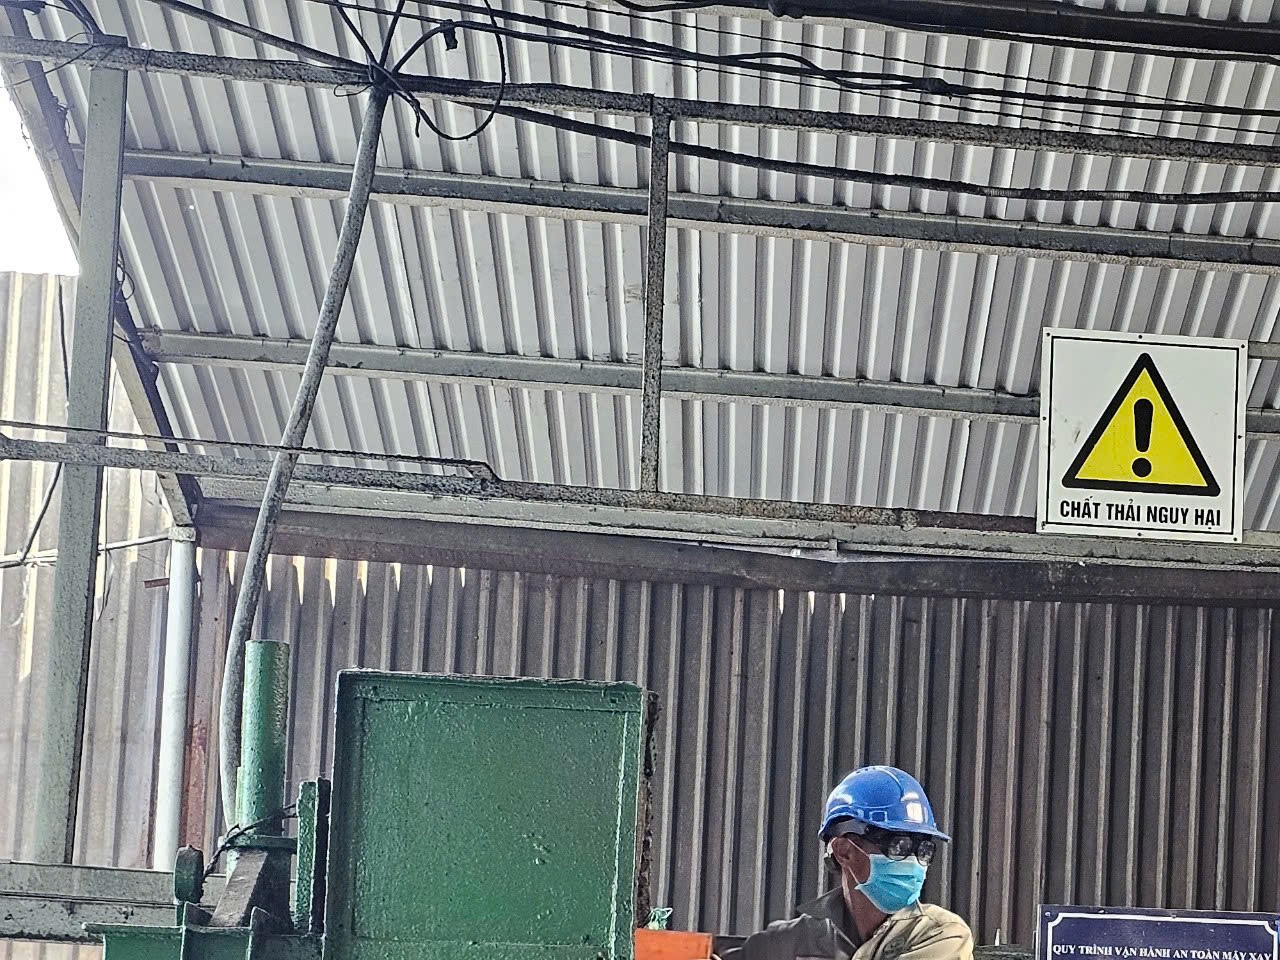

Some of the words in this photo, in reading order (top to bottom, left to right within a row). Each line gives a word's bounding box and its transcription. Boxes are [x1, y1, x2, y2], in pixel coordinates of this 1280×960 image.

[1060, 497, 1102, 519] CHẤT
[1106, 502, 1141, 521] THẢI
[1147, 506, 1189, 524] NGUY
[1194, 508, 1220, 528] HẠI
[1053, 945, 1076, 955] QUY
[1079, 943, 1112, 955] TRÌNH
[1140, 946, 1170, 958] HÀNH
[1173, 949, 1188, 959] AN
[1190, 948, 1220, 960] TOÀN
